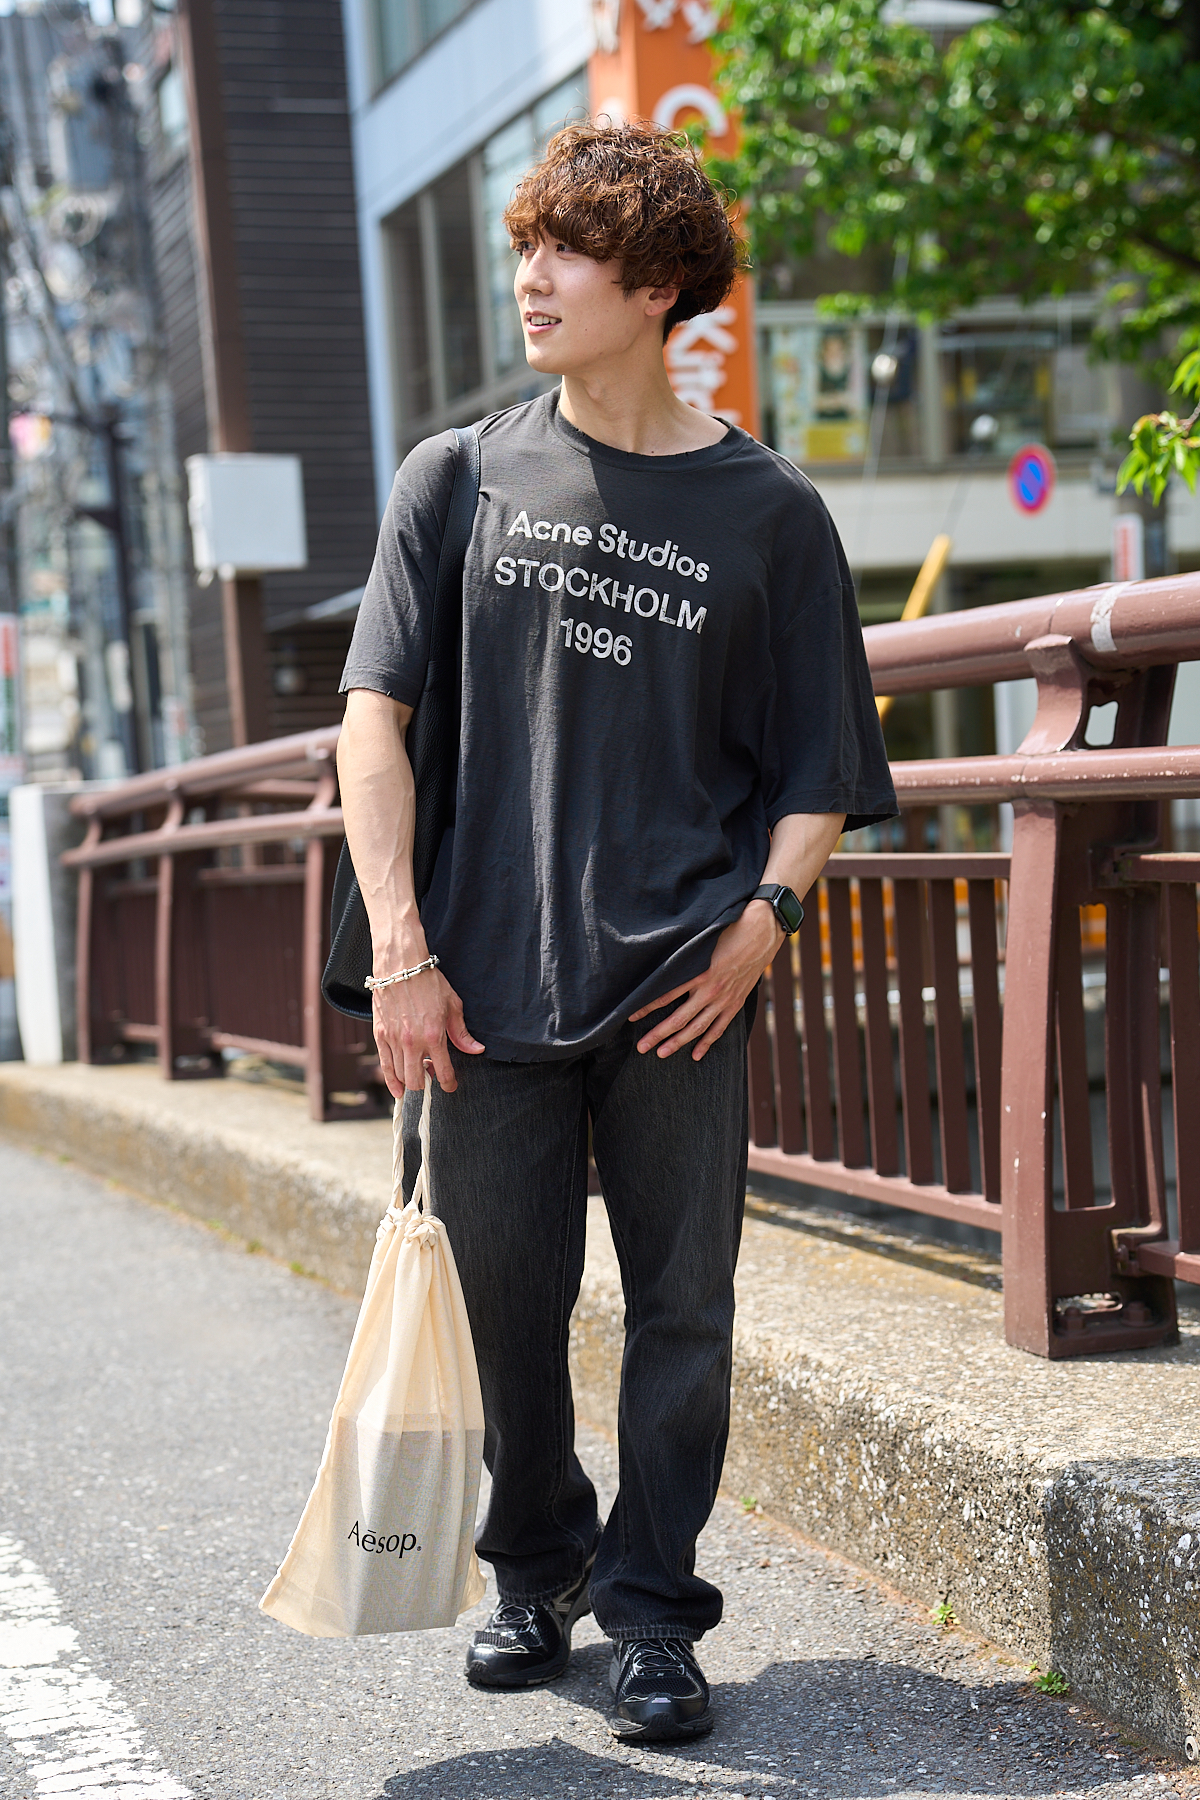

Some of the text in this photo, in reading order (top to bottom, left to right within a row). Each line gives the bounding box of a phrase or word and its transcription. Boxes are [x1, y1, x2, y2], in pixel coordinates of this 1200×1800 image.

[667, 306, 742, 427] Kitc
[507, 511, 710, 583] Acne Studios
[494, 556, 708, 635] STOCKHOLM
[560, 617, 633, 666] 1996
[348, 1520, 422, 1559] Aēsop.
